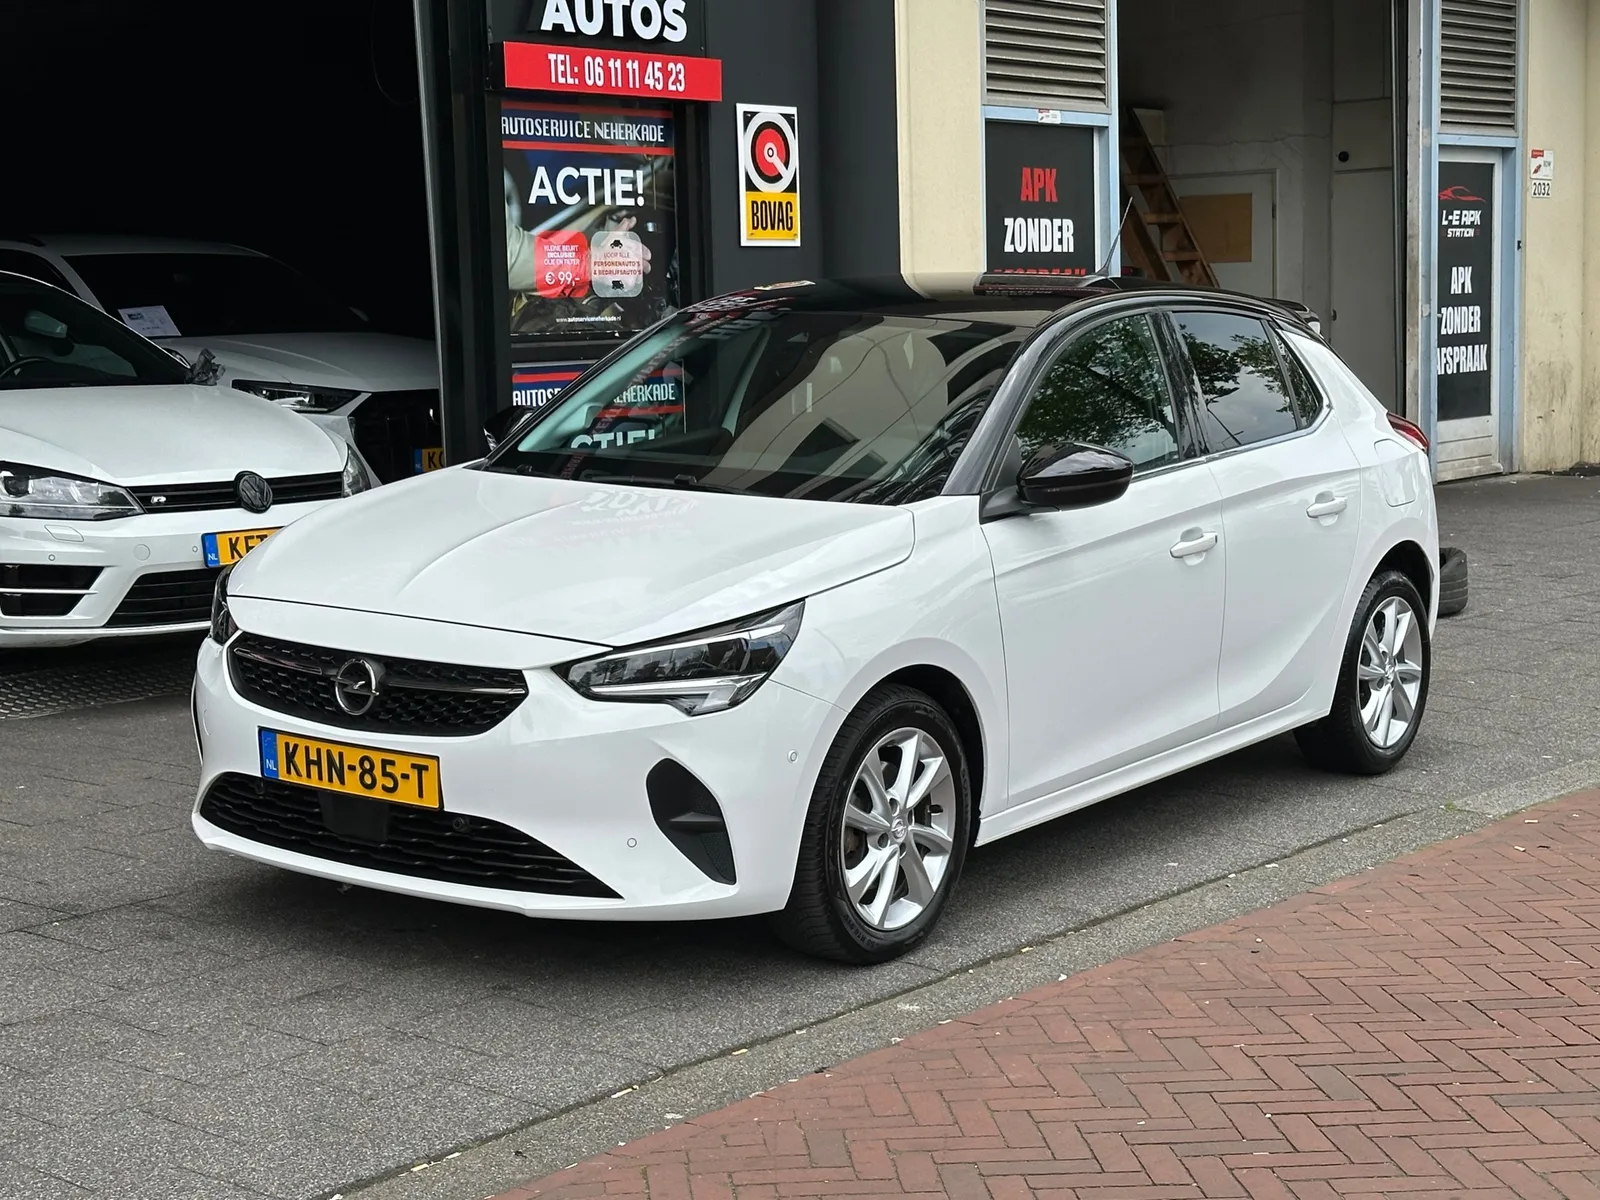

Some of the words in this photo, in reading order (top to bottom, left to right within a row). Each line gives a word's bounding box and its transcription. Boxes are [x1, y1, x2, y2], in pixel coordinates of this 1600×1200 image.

[540, 0, 687, 42] AUTOS
[547, 53, 579, 85] TEL:
[584, 56, 604, 87] 06
[608, 58, 622, 88] 11
[626, 60, 640, 89] 11
[644, 61, 664, 91] 45
[668, 62, 686, 92] 23
[501, 116, 592, 139] AUTOSERVICE
[594, 121, 665, 143] NEHERKADE
[528, 166, 645, 207] ACTIE!
[1020, 167, 1058, 202] APK
[1533, 181, 1550, 196] 2032
[751, 200, 794, 231] BOVAG
[1441, 209, 1461, 225] L-E
[1461, 209, 1482, 225] APK
[1004, 217, 1074, 252] ZONDER
[1447, 227, 1475, 238] STATION
[545, 271, 555, 285] €
[558, 271, 580, 287] 99,-
[1450, 266, 1473, 295] APK
[1440, 305, 1481, 335] ZONDER
[207, 553, 218, 561] NL
[265, 758, 277, 771] NL
[284, 741, 429, 799] KHN-85-T
